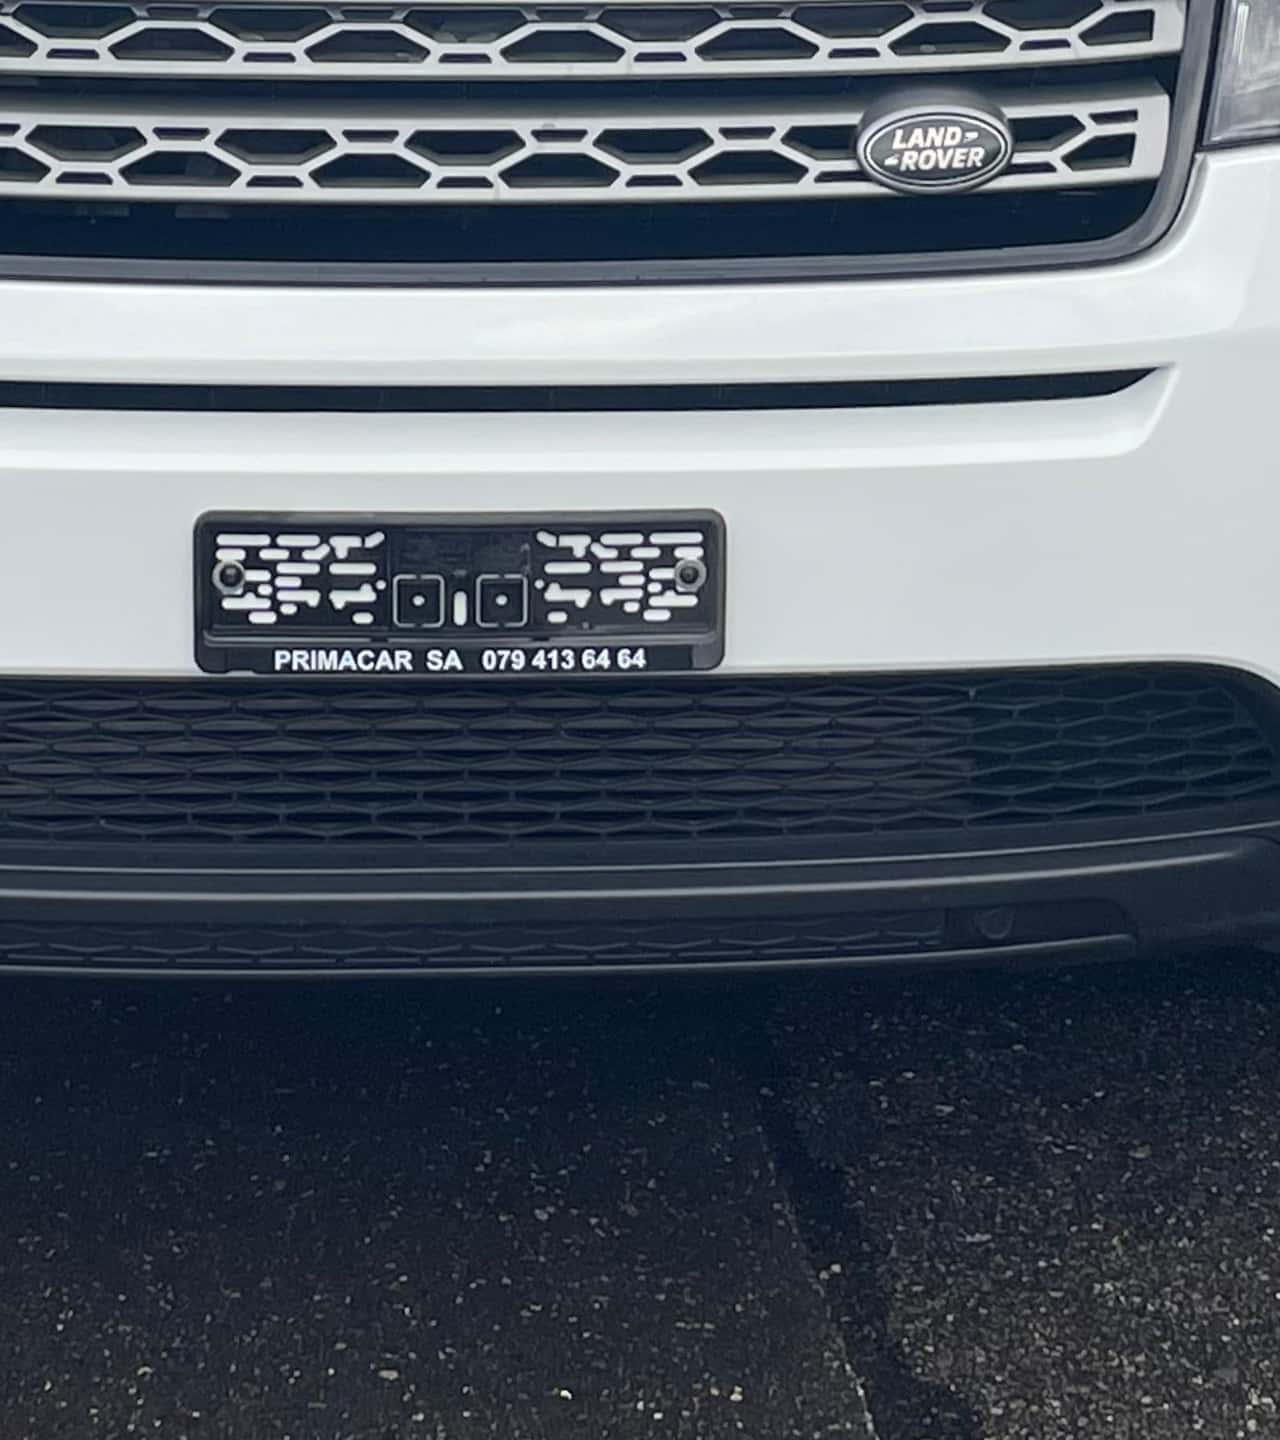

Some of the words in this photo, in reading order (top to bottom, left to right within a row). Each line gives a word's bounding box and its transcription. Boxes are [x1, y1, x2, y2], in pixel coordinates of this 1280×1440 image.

[891, 125, 963, 150] LAND
[899, 146, 985, 172] ROVER
[273, 648, 414, 672] PRIMACAR
[425, 648, 464, 671] SA
[481, 648, 526, 671] 079
[531, 648, 575, 670] 413
[581, 648, 611, 670] 64
[616, 648, 647, 669] 64
